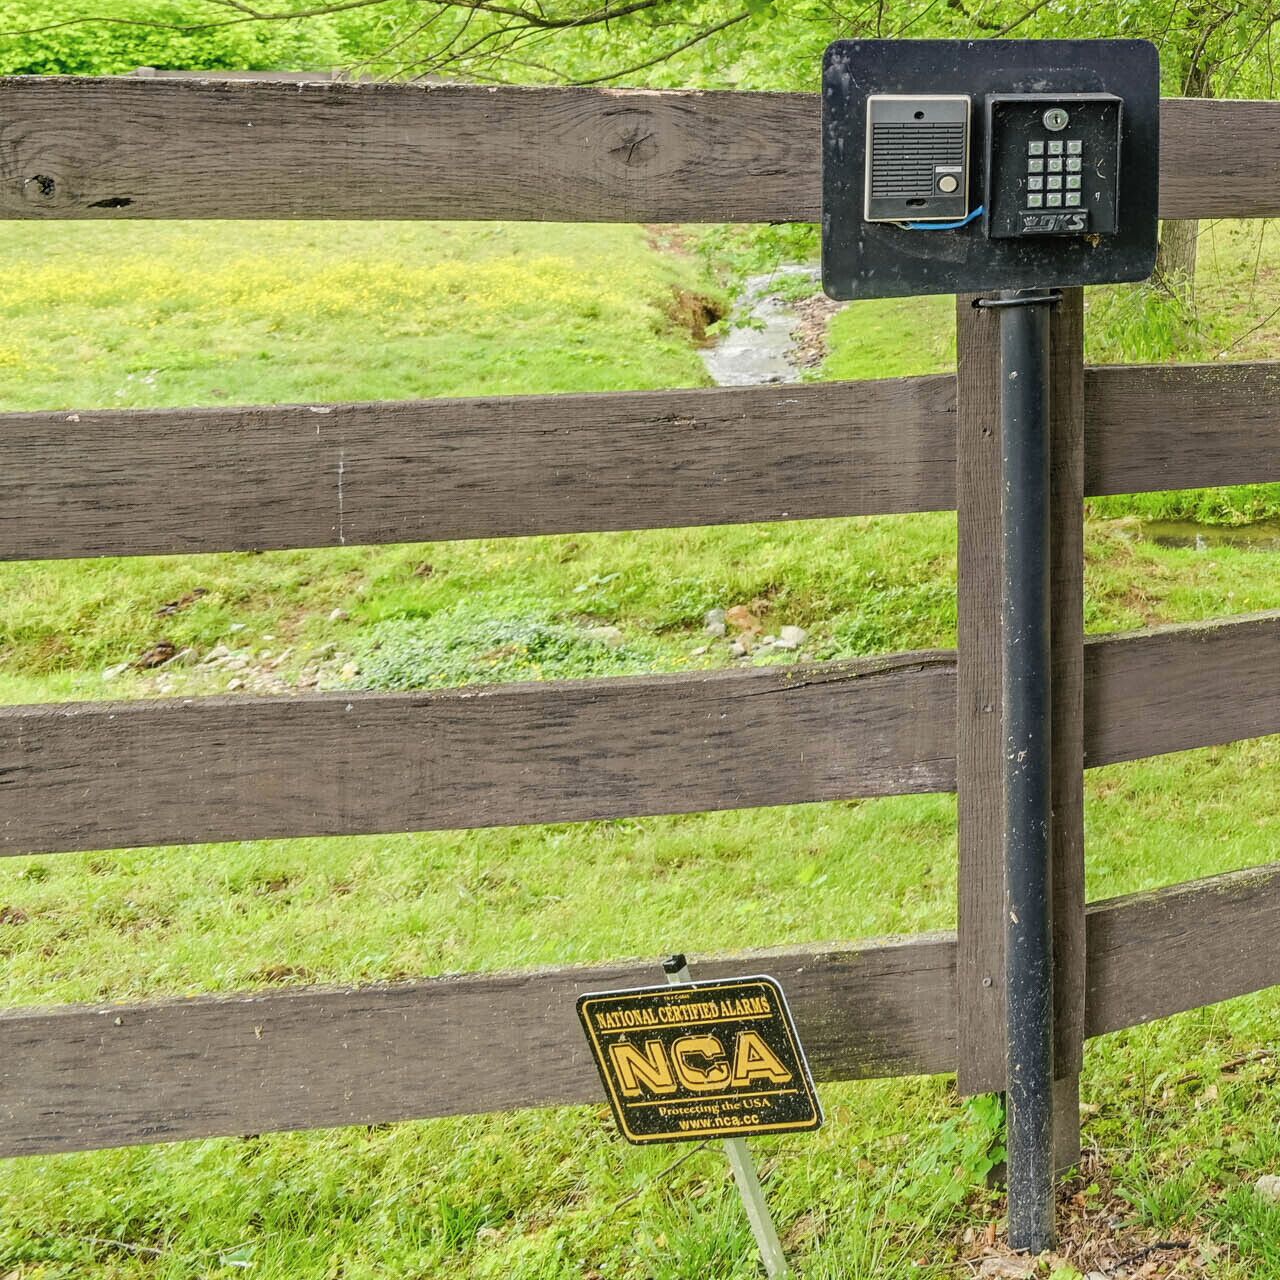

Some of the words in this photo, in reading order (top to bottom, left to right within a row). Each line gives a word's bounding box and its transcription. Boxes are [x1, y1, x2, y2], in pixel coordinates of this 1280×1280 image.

[595, 1010, 659, 1030] NATIONAL
[658, 1003, 719, 1024] CERTIFIED
[719, 997, 771, 1017] ALARMS
[608, 1030, 793, 1097] NCA
[659, 1103, 720, 1117] Protecting
[721, 1101, 741, 1112] the
[742, 1098, 772, 1109] USA
[679, 1114, 760, 1131] www.nca.cc
